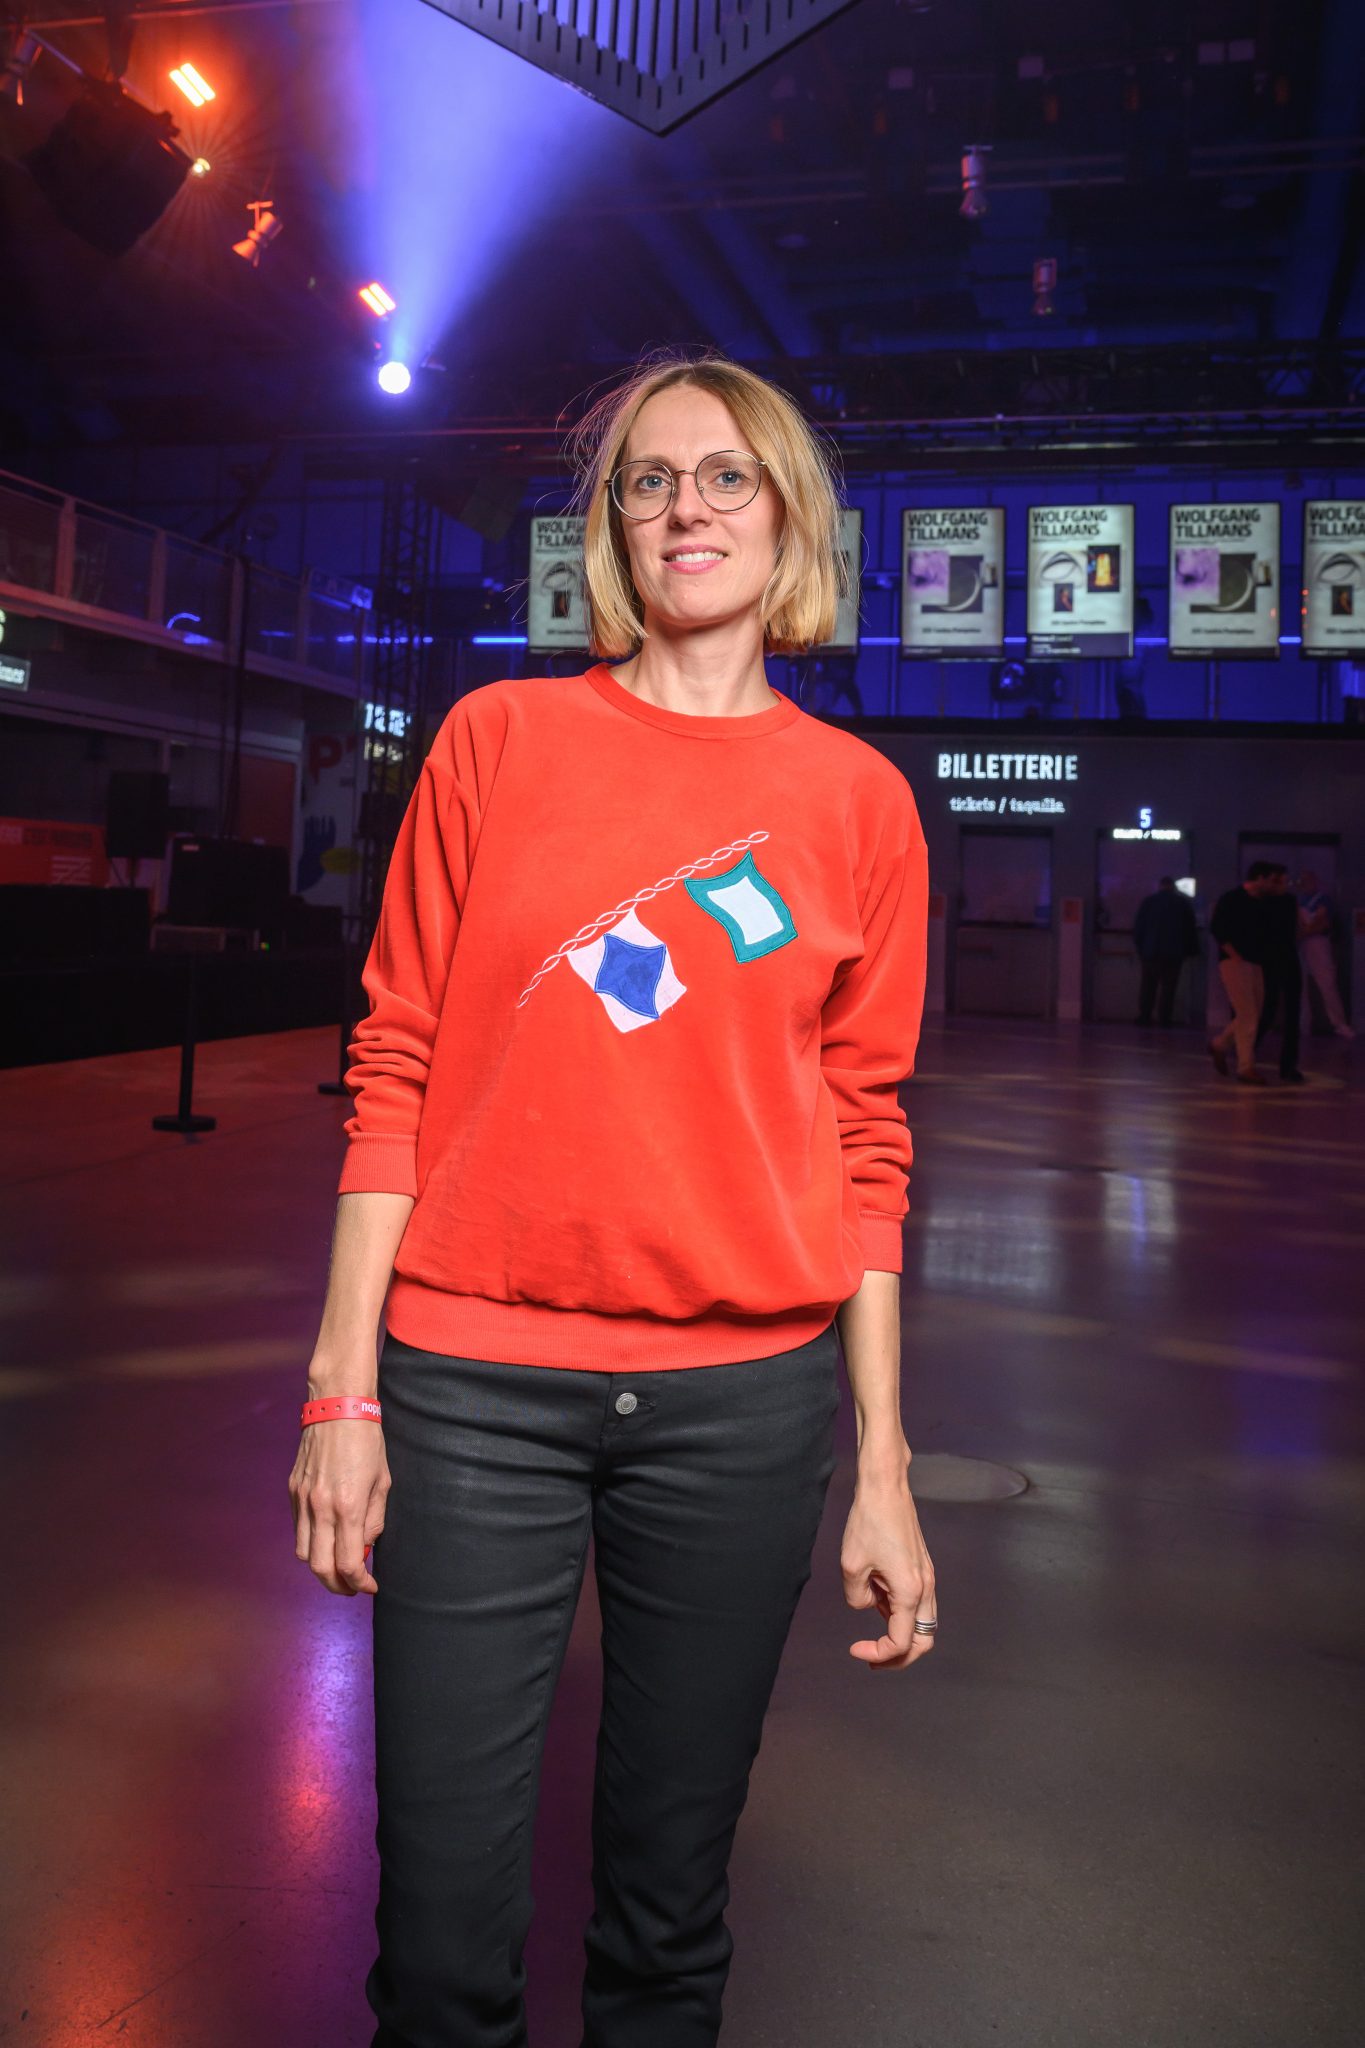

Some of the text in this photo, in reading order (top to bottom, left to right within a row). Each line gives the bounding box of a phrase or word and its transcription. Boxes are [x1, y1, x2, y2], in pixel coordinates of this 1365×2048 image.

[908, 512, 988, 526] WOLFGANG
[1033, 509, 1108, 522] WOLFGANG
[1175, 508, 1261, 523] WOLFGANG
[908, 527, 980, 540] TILLMANS
[1033, 523, 1100, 536] TILLMANS
[1175, 523, 1252, 538] TILLMANS
[937, 753, 1079, 781] BILLETTERIE
[950, 796, 996, 812] tickets
[1140, 808, 1152, 829] 5
